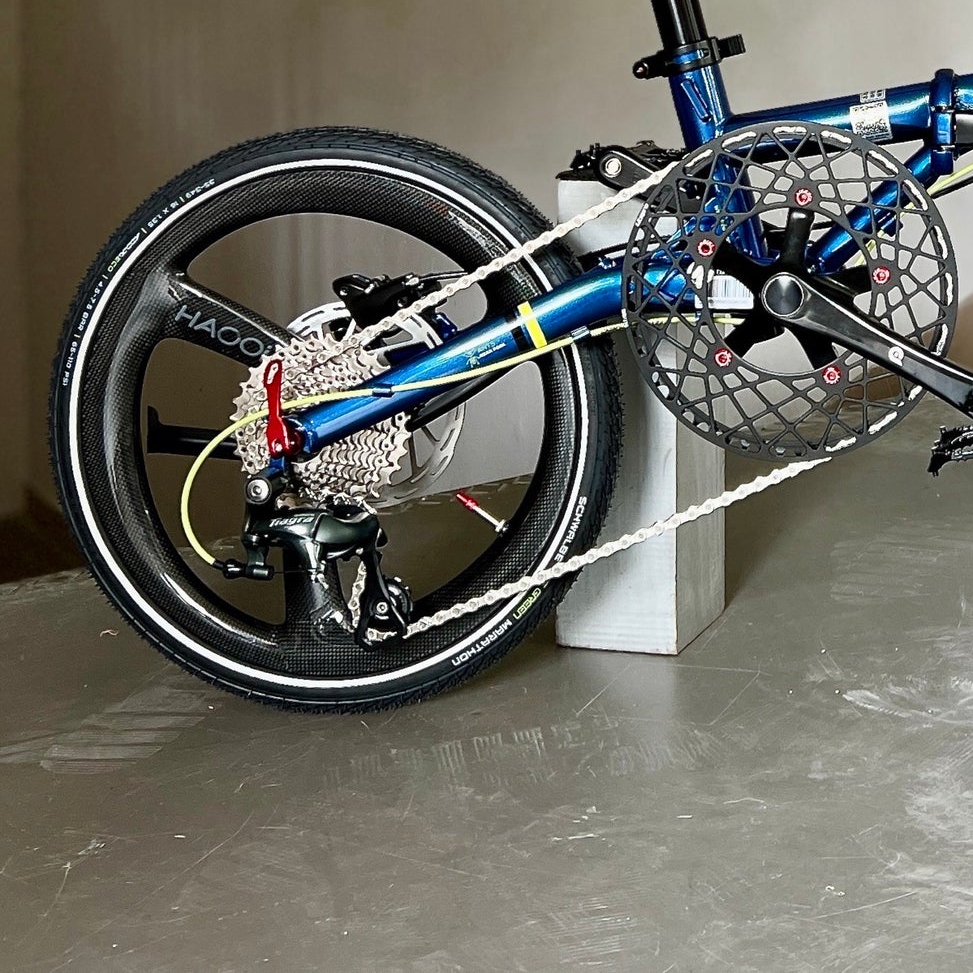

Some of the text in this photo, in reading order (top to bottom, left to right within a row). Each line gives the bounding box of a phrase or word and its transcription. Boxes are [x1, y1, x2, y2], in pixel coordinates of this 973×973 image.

[269, 516, 315, 528] Tiagra
[554, 496, 588, 563] SCHWALBE
[451, 619, 513, 667] MARATHON
